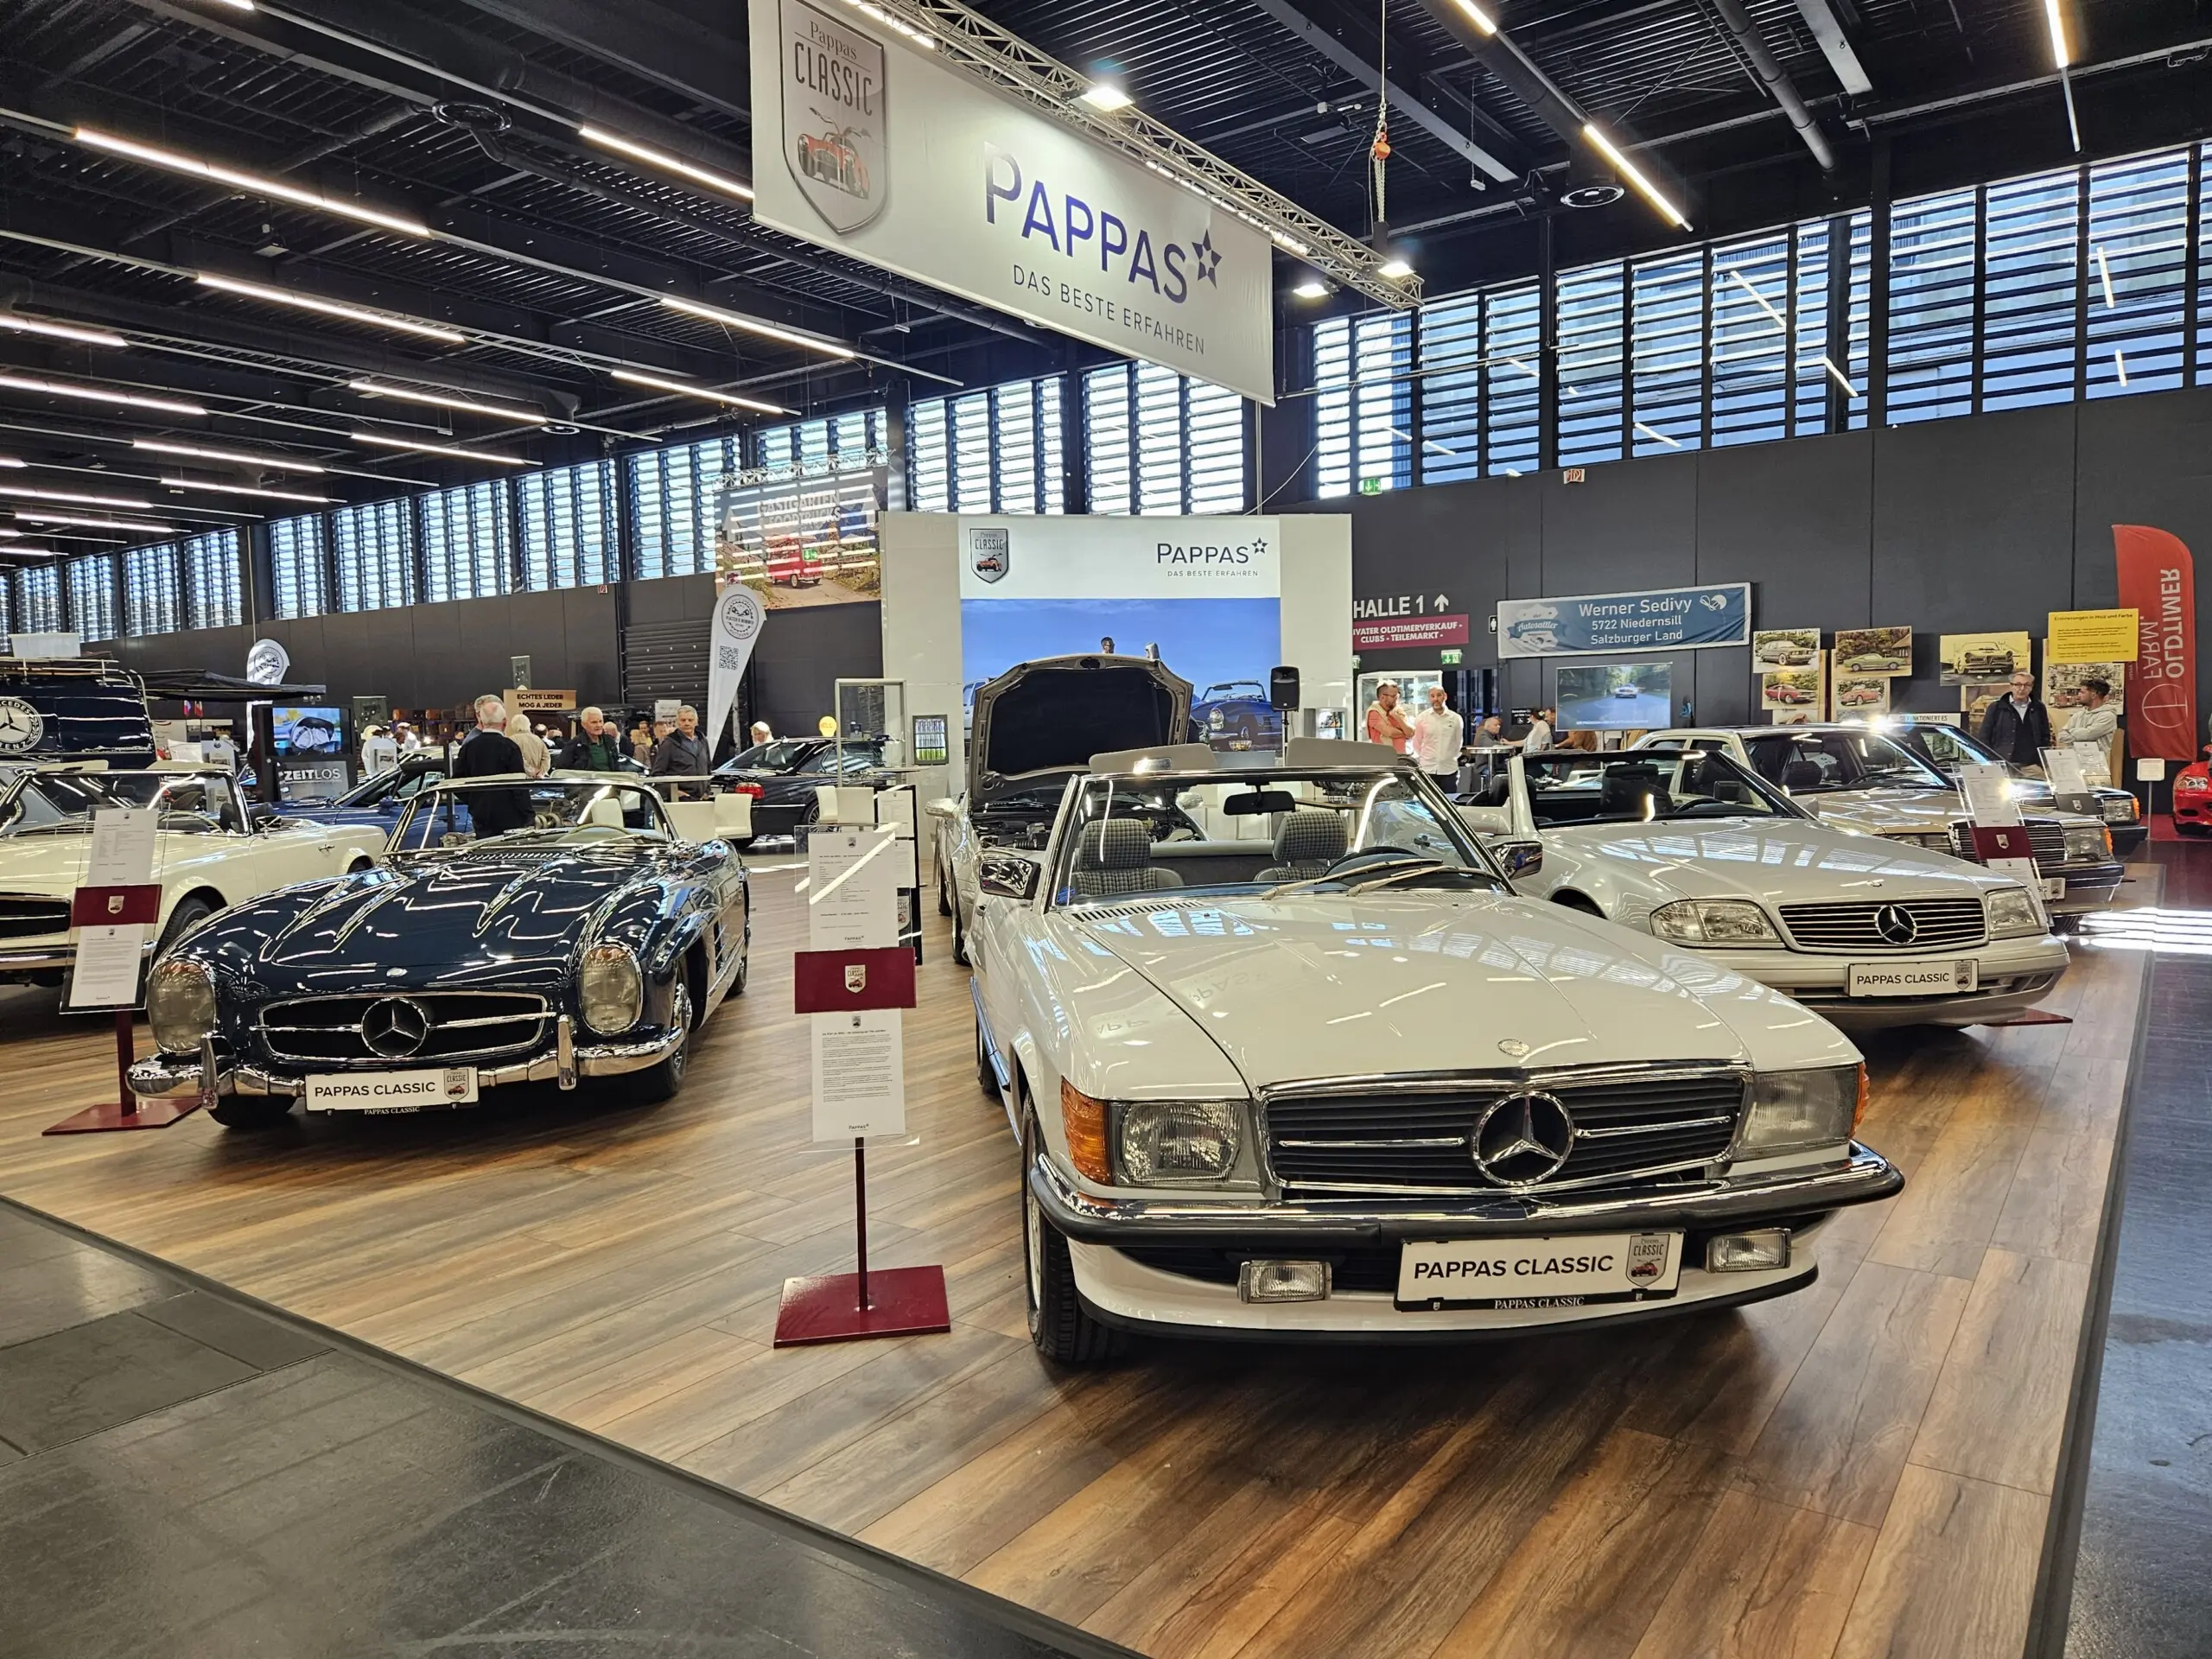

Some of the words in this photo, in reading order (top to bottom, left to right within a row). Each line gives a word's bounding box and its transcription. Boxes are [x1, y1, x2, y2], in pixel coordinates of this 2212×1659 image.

[810, 20, 858, 60] Pappas
[795, 41, 873, 116] CLASSIC
[983, 141, 1188, 304] PAPPAS
[1014, 264, 1052, 296] DAS
[1060, 283, 1116, 321] BESTE
[1123, 308, 1205, 355] ERFAHREN
[975, 538, 1003, 550] CLASSIC
[1157, 543, 1249, 563] PAPPAS
[1353, 596, 1411, 619] HALLE
[1416, 594, 1424, 614] 1
[1579, 602, 1635, 617] Werner
[1640, 598, 1693, 613] Sedivy
[1353, 626, 1379, 636] IVATER
[1380, 621, 1458, 634] OLDTIMERVERKAUF
[1592, 620, 1617, 630] 5722
[1620, 614, 1682, 628] Niedernsill
[1360, 634, 1384, 644] CLUBS
[1391, 631, 1440, 642] TEILEMARKT
[1590, 632, 1652, 645] Salzburger
[1655, 629, 1682, 641] Land
[0, 700, 31, 715] CEDES
[283, 768, 341, 781] ZEITLOS
[1857, 975, 1902, 985] PAPPAS
[1904, 973, 1950, 983] CLASSIC
[315, 1084, 370, 1097] PAPPAS
[373, 1081, 436, 1095] CLASSIC
[1633, 1244, 1665, 1256] CLASSIC
[1414, 1260, 1507, 1280] PAPPAS
[1514, 1255, 1614, 1275] CLASSIC
[1494, 1299, 1535, 1310] PAPPAS
[1537, 1296, 1586, 1308] CLASSIC
